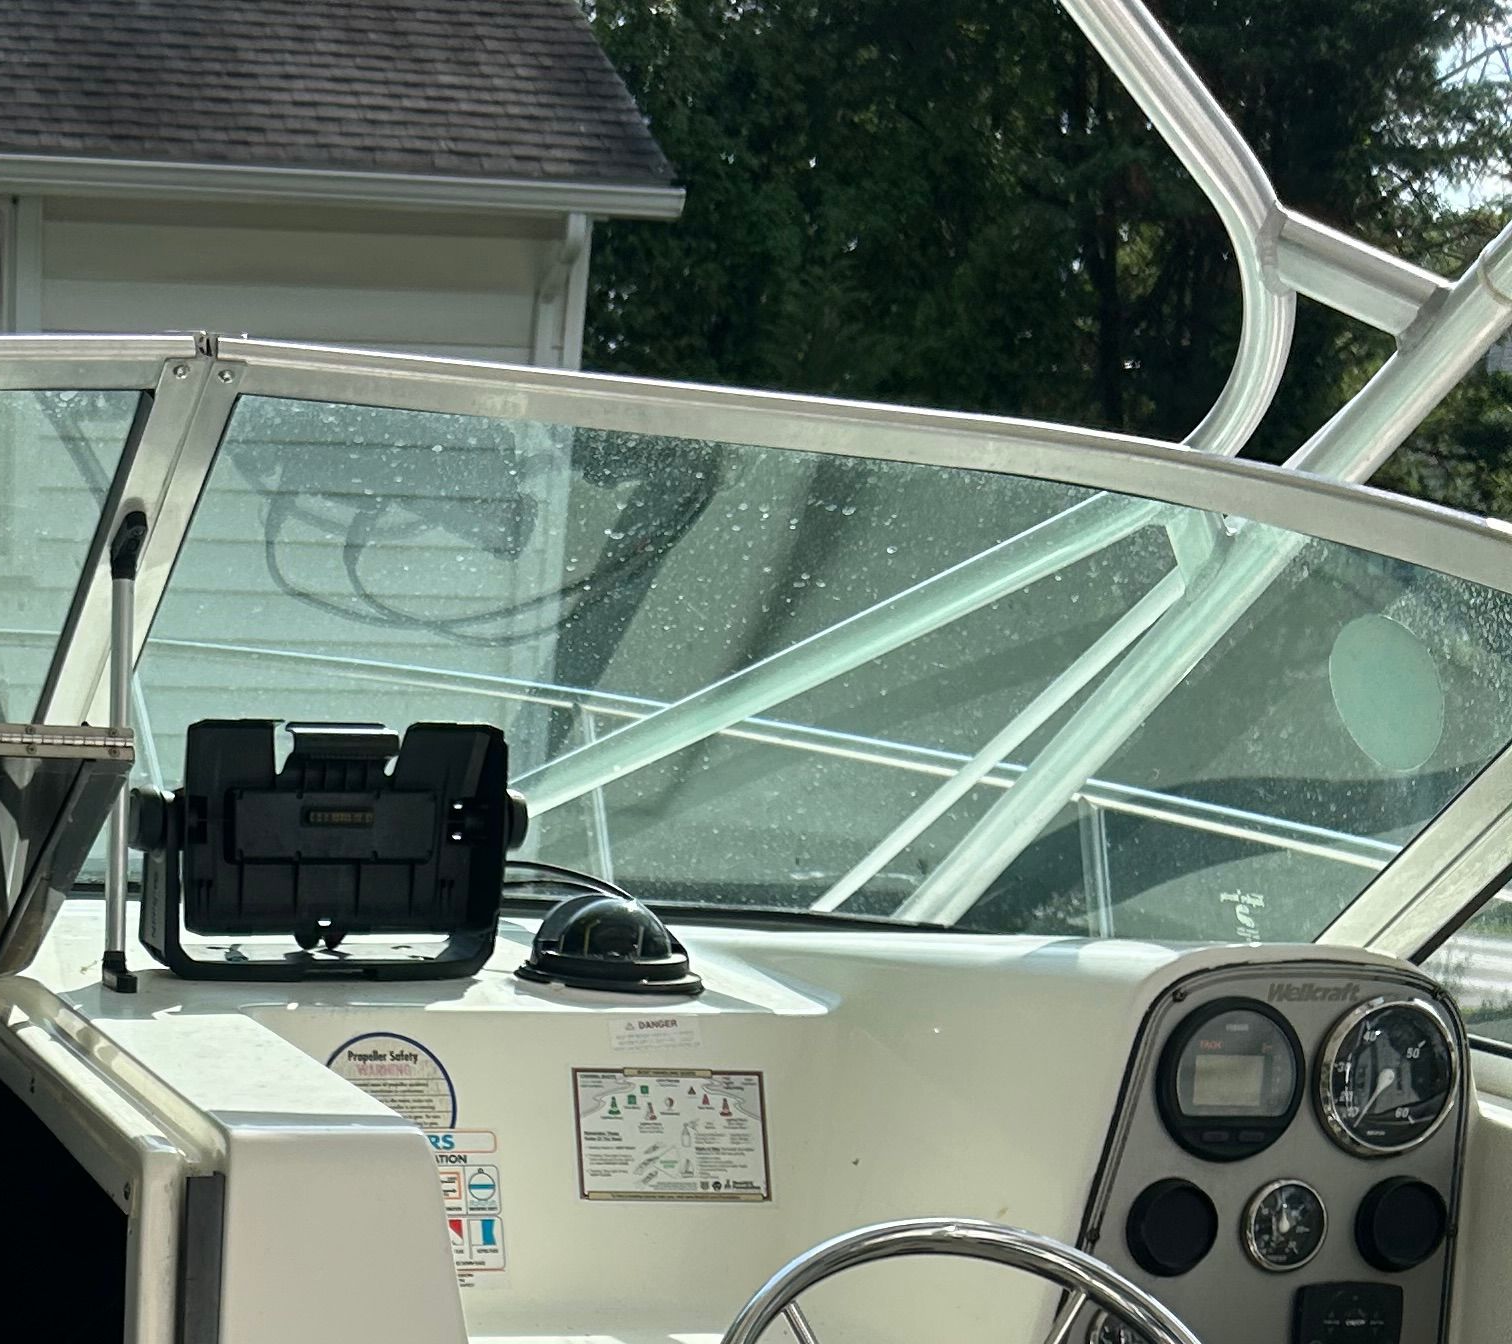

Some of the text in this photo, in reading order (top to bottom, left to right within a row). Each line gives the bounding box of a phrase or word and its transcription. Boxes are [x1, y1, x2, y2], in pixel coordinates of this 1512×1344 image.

[1268, 982, 1360, 1001] Wellcraft
[638, 1019, 678, 1030] DANGER
[1363, 1032, 1377, 1041] 40
[348, 1050, 418, 1064] Propeller Safety
[1406, 1048, 1420, 1058] 50
[1395, 1108, 1409, 1118] 60
